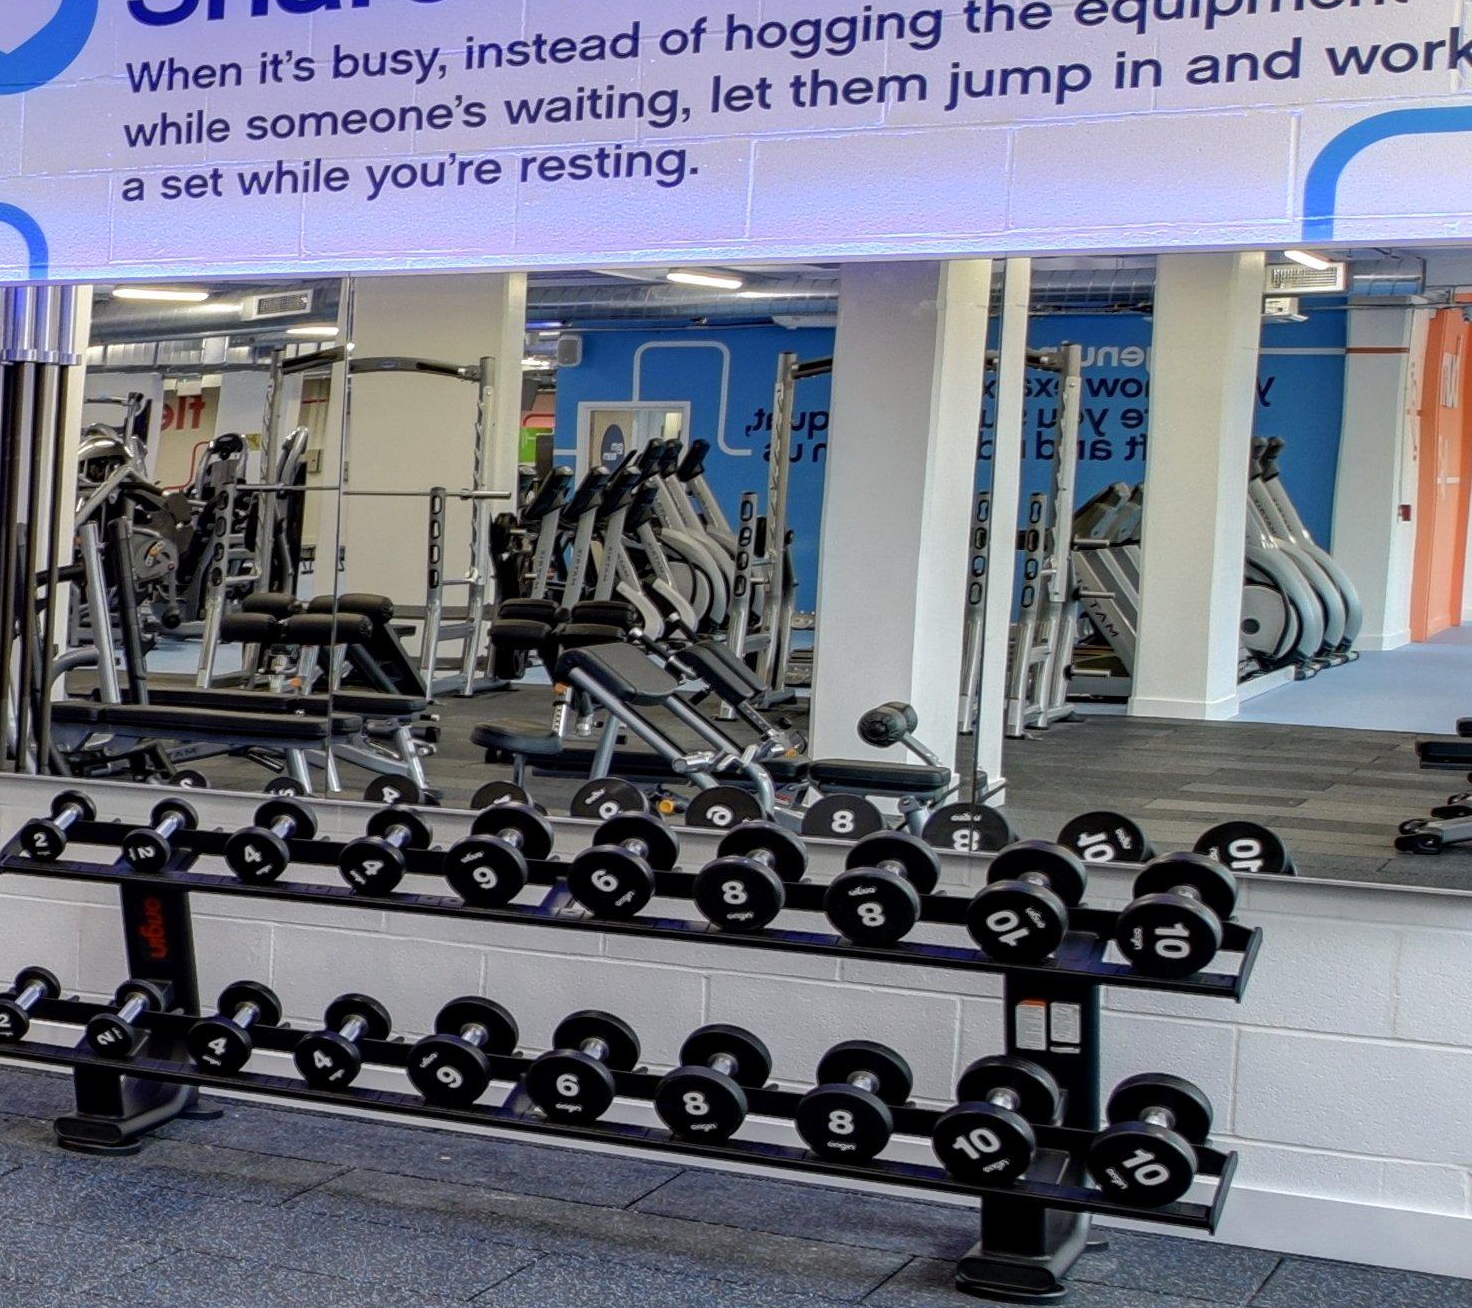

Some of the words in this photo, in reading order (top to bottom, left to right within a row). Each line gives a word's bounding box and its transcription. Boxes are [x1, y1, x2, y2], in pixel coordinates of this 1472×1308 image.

[126, 56, 242, 93] When
[259, 50, 315, 86] it's
[332, 43, 447, 85] busy,
[464, 21, 640, 72] instead
[659, 16, 707, 57] of
[724, 2, 942, 59] hogging
[123, 111, 230, 148] while
[246, 93, 487, 141] someone's
[504, 83, 691, 128] waiting,
[710, 75, 773, 115] let
[790, 66, 928, 108] them
[945, 58, 1093, 111] jump
[1114, 50, 1161, 89] in
[1185, 36, 1302, 85] and
[1325, 26, 1472, 76] work
[122, 171, 146, 202] a
[160, 167, 223, 199] set
[237, 158, 350, 195] while
[366, 152, 502, 200] you're
[520, 142, 700, 191] resting.
[34, 832, 48, 848] 2
[244, 844, 262, 862] 4
[363, 860, 384, 875] 4
[591, 869, 618, 892] 6
[721, 881, 748, 905] 8
[857, 902, 886, 927] 8
[986, 910, 1030, 947] 10
[1154, 922, 1191, 959] 10
[207, 1037, 227, 1055] 4
[313, 1050, 333, 1069] 4
[556, 1074, 580, 1097] 6
[682, 1092, 709, 1115] 8
[828, 1110, 855, 1134] 8
[952, 1128, 1001, 1160] 10
[1122, 1149, 1170, 1186] 10
